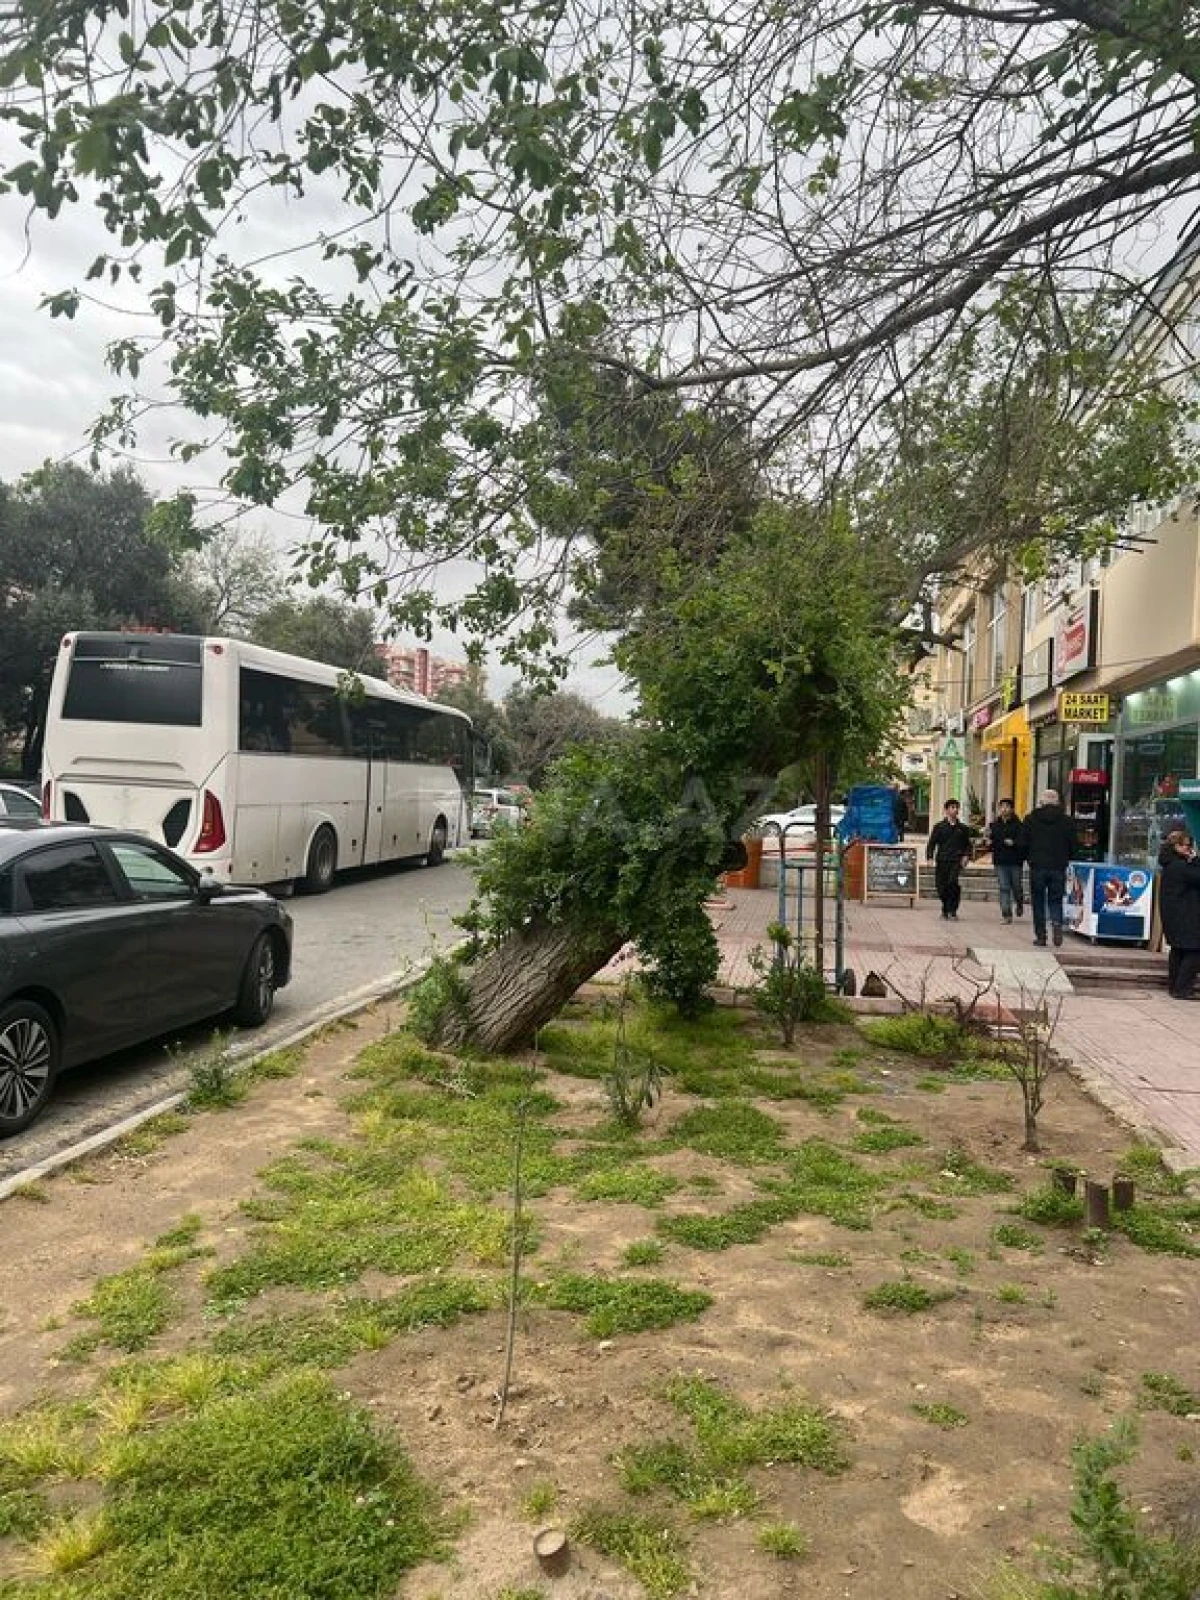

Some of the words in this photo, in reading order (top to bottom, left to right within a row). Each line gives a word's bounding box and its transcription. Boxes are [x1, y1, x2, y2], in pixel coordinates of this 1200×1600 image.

[1065, 695, 1077, 705] 24
[1080, 695, 1105, 705] SAAT
[1064, 707, 1105, 719] MARKET
